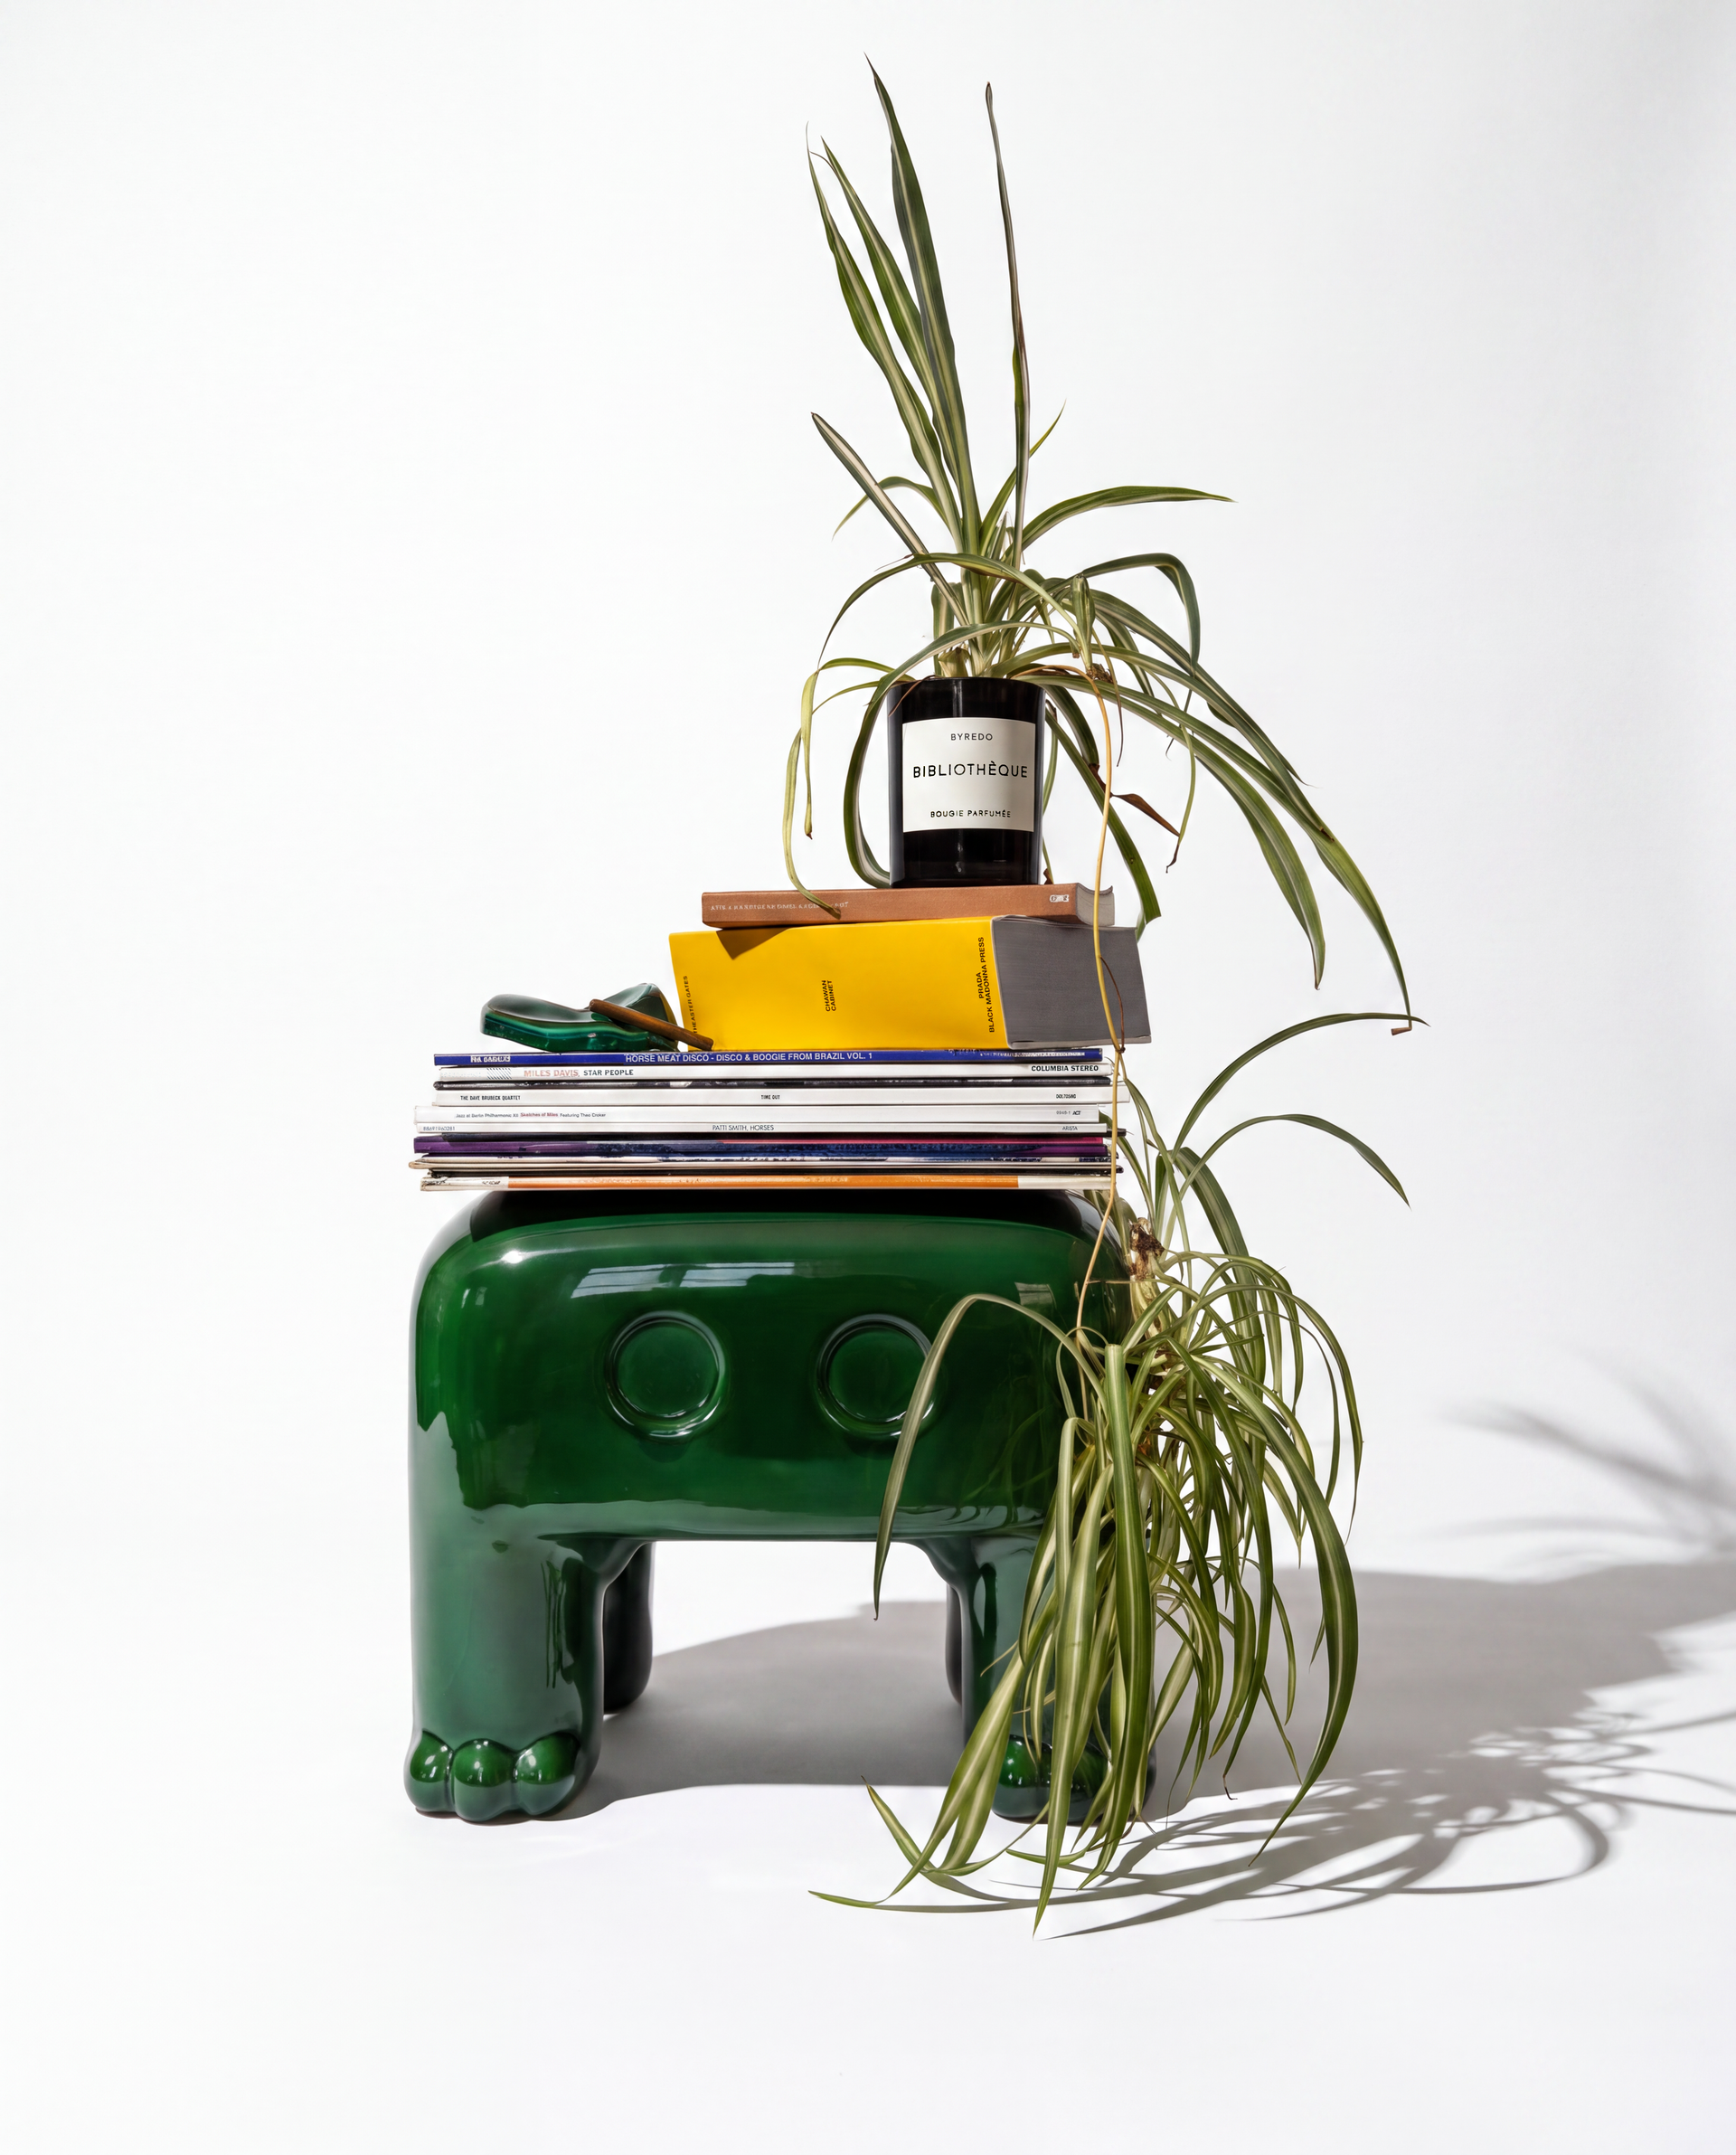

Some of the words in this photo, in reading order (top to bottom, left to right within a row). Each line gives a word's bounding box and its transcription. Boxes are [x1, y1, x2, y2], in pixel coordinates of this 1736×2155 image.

[950, 733, 993, 741] BYREDO
[913, 761, 1028, 778] BIBLIOTHÈQUE
[930, 810, 964, 818] BOUGIE
[967, 809, 1011, 818] PARFUMÉE
[978, 937, 986, 963] PRESS
[683, 976, 692, 997] GATES
[821, 979, 831, 1012] CHAWAN
[826, 979, 836, 1012] CABINET
[976, 972, 985, 999] PRADA
[981, 964, 992, 1005] MADONNA
[986, 1007, 995, 1033] BLACK
[625, 1054, 656, 1063] HORSE
[657, 1054, 680, 1063] MEAT
[682, 1054, 709, 1063] DISCO
[716, 1054, 743, 1062] DISCO
[745, 1054, 751, 1062] &
[752, 1054, 786, 1062] BOOGIE
[788, 1053, 813, 1061] FROM
[815, 1053, 845, 1061] BRAZIL
